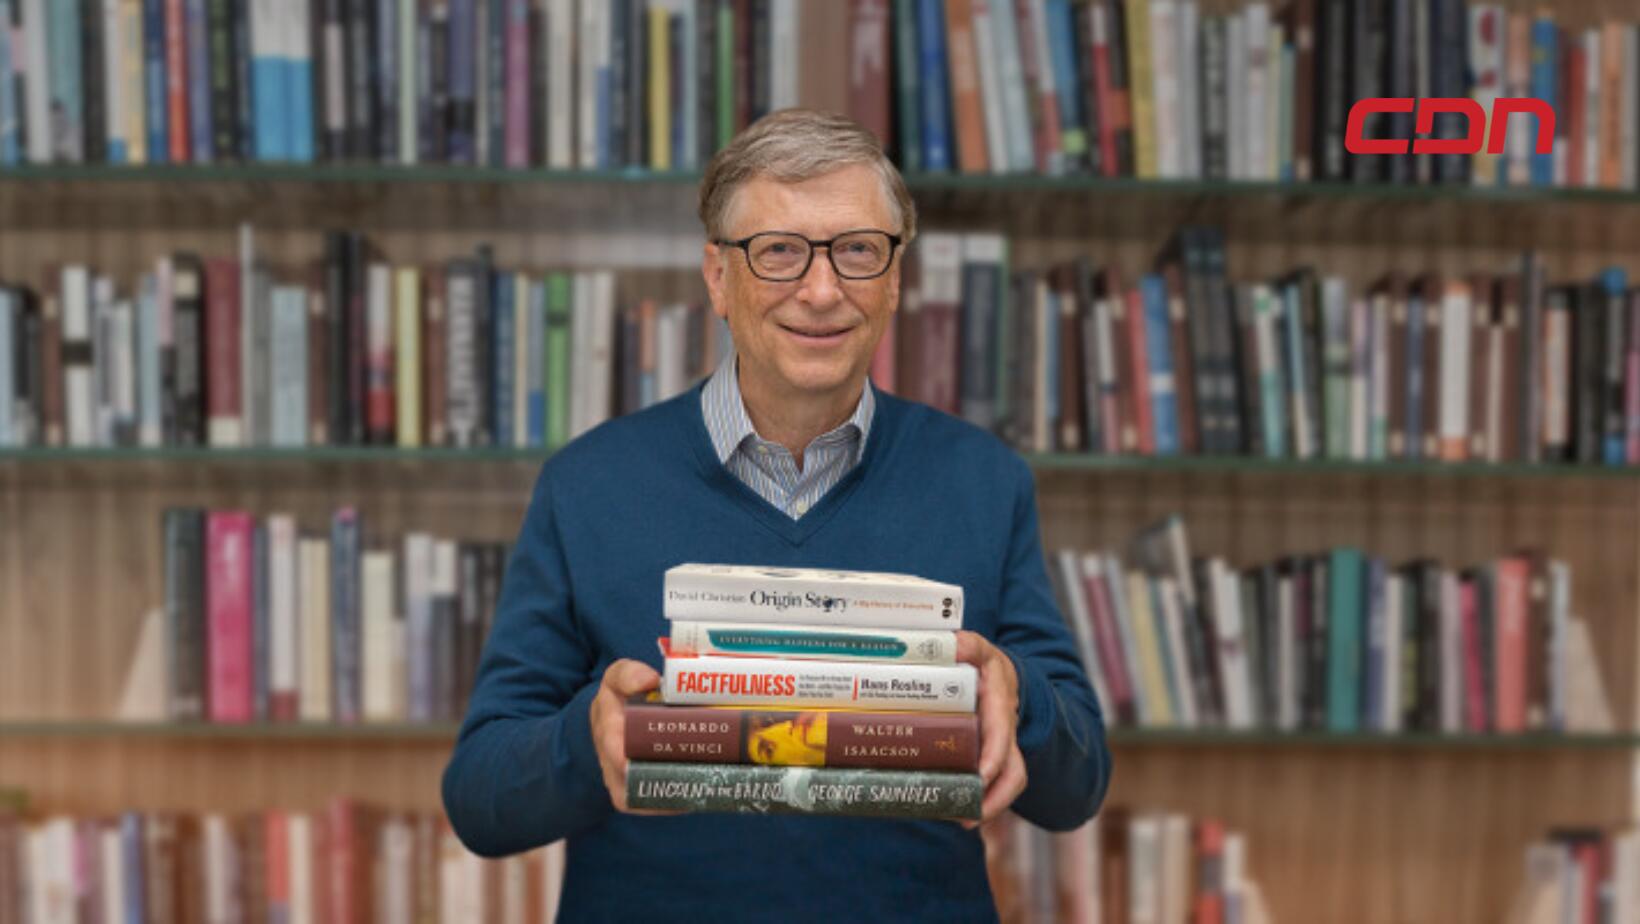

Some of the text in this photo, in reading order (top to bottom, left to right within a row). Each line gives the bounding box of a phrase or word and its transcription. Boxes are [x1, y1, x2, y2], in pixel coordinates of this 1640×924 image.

[750, 590, 802, 612] Origin
[805, 592, 847, 613] Story
[676, 671, 796, 697] FACTFULNESS
[861, 679, 889, 690] Hans
[891, 679, 932, 693] Rosling
[648, 722, 730, 734] LEONARDO
[852, 724, 914, 736] WALTER
[653, 743, 723, 754] DA VINCI
[844, 745, 921, 758] ISAACSON
[637, 780, 704, 798] LINCOLN
[733, 782, 783, 800] BARDO
[808, 783, 942, 804] GEORGE SAUNDERS
